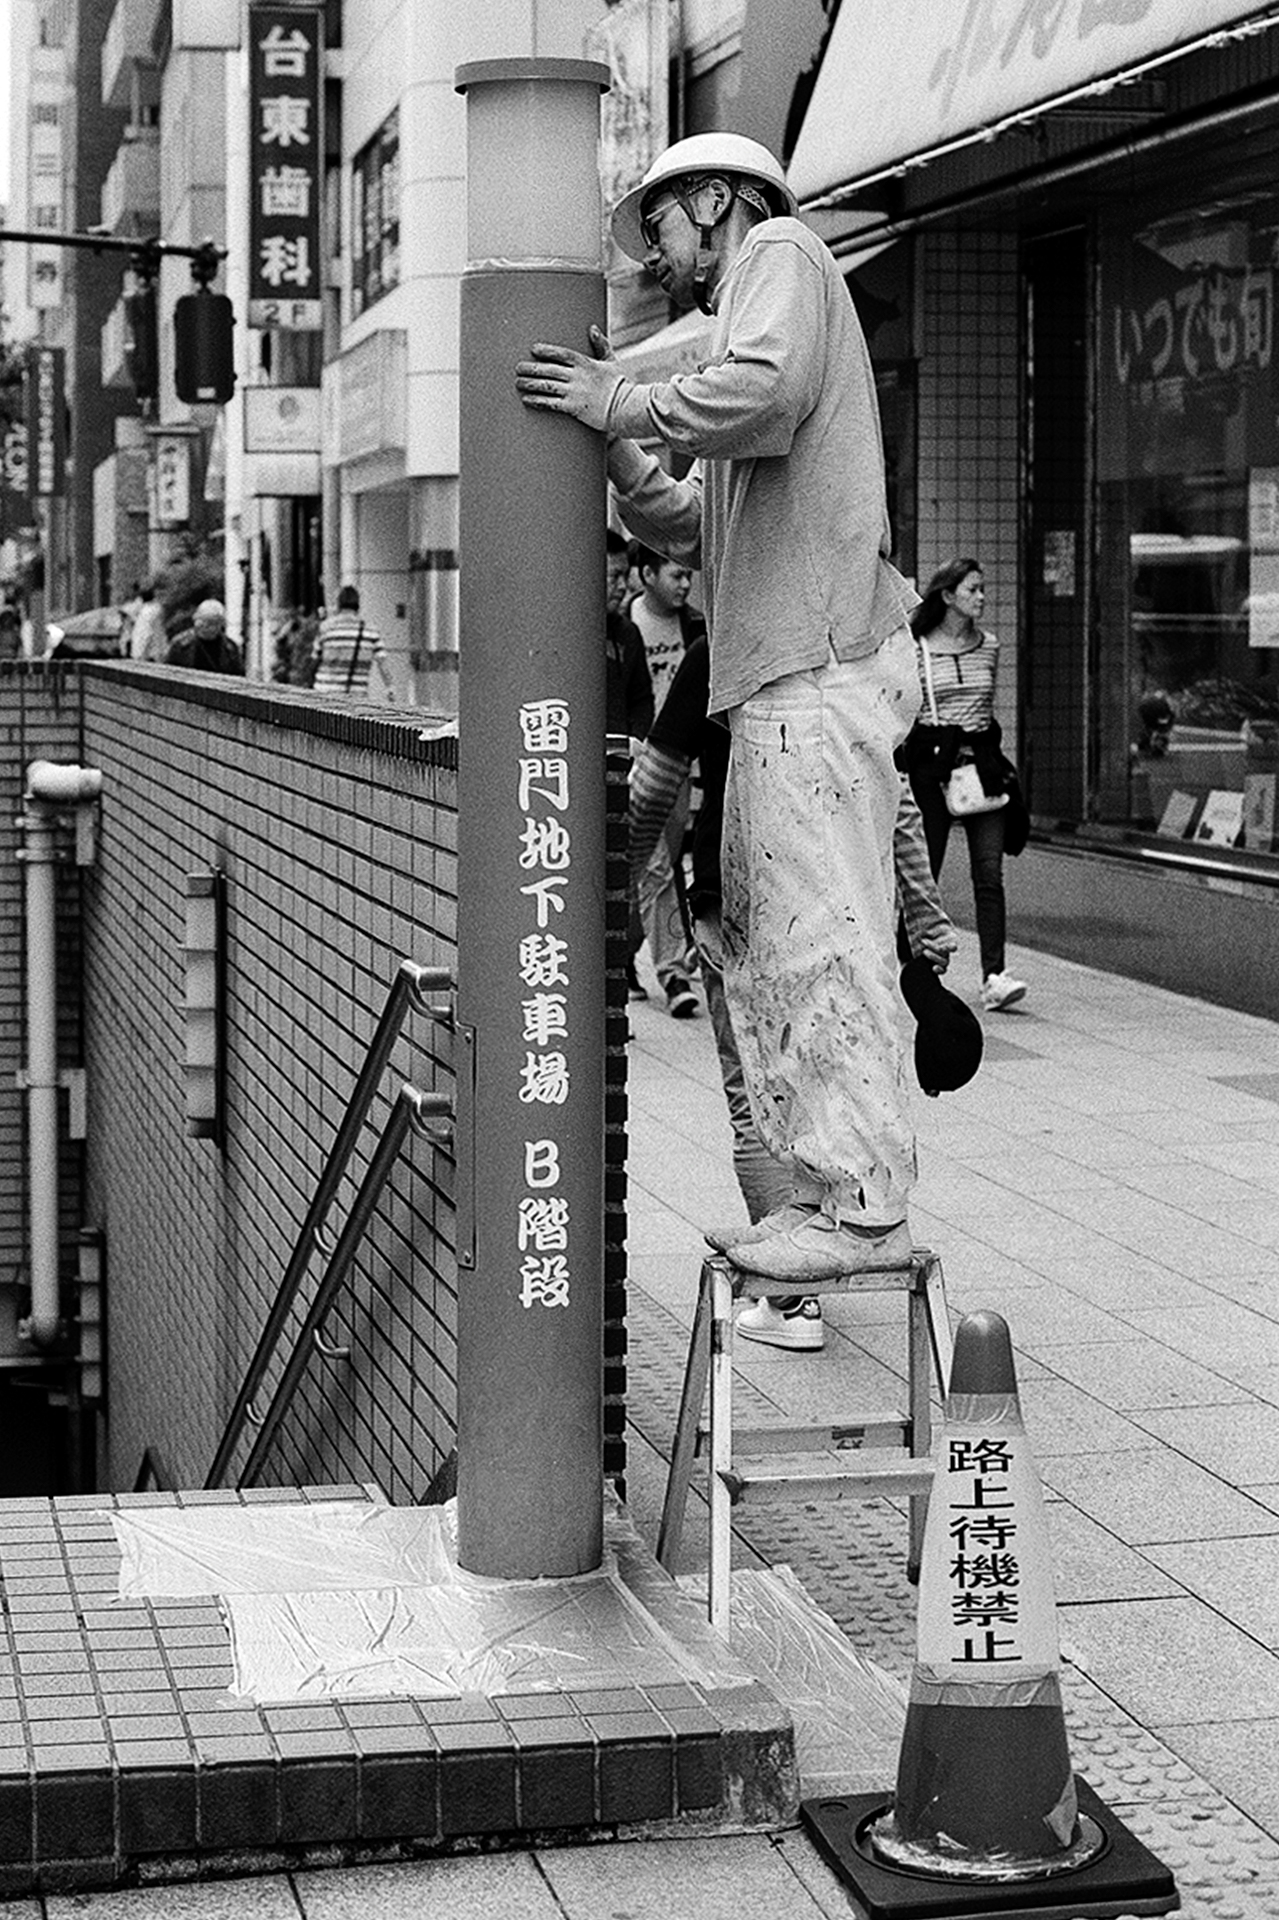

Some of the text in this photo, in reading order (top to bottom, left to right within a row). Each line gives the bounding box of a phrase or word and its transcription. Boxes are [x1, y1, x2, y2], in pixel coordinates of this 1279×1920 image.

[258, 24, 312, 287] 台東歯科
[264, 303, 306, 325] 2F
[518, 698, 571, 1309] 雷門地下駐車場 B階段
[948, 1438, 1022, 1663] 路上待機禁止
